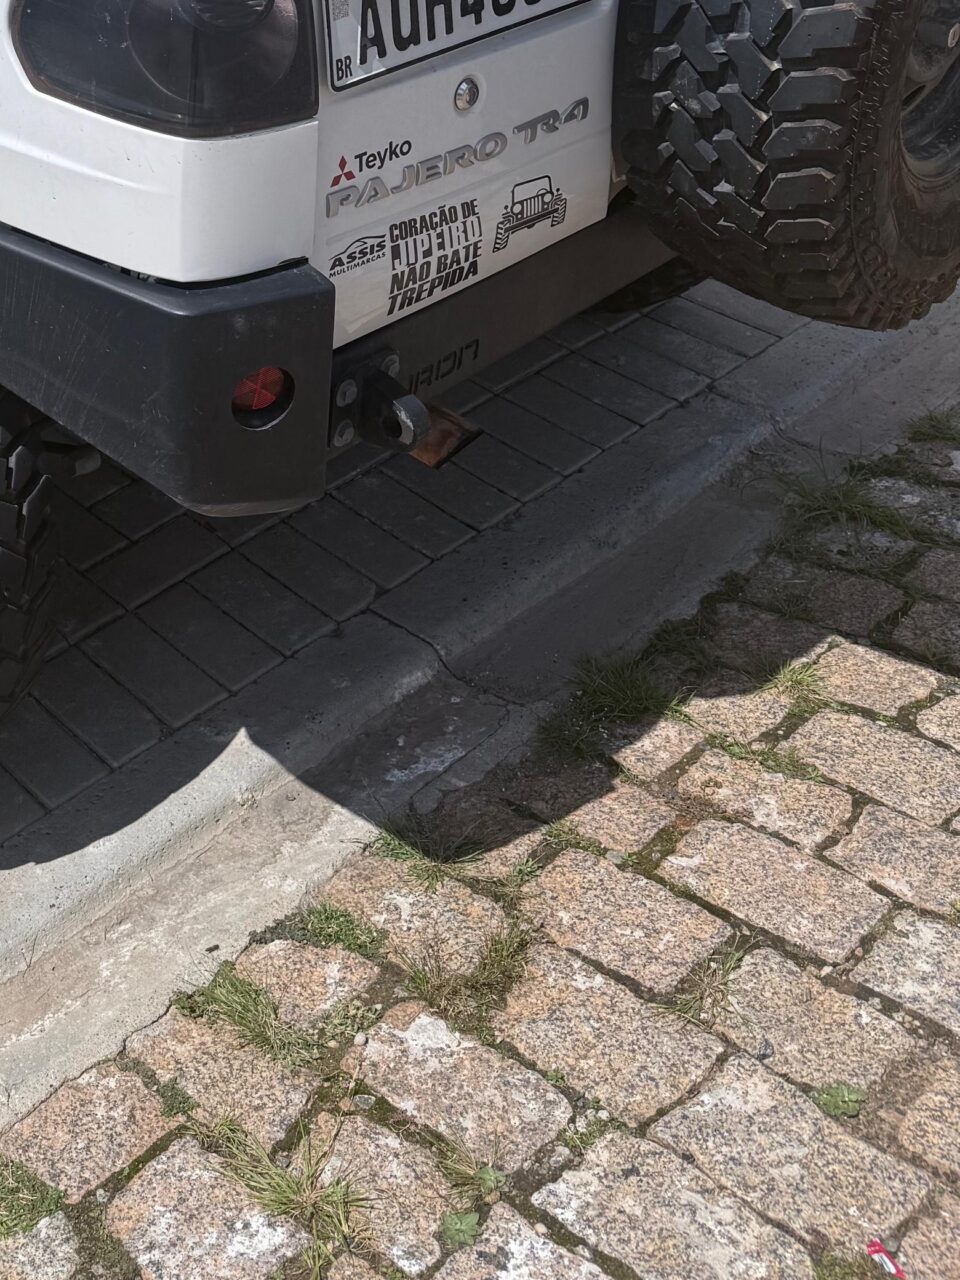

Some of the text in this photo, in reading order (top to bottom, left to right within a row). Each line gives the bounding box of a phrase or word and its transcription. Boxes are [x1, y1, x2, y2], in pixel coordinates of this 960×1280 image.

[335, 55, 353, 81] BR
[325, 130, 509, 218] PAJERO
[354, 139, 413, 173] Teyko
[389, 199, 480, 244] CORAÇÃO DE
[328, 251, 387, 278] MULTIMARCAS
[329, 240, 387, 271] ASSIS
[390, 239, 483, 295] NÃO BATE
[387, 259, 479, 317] TREPIDA
